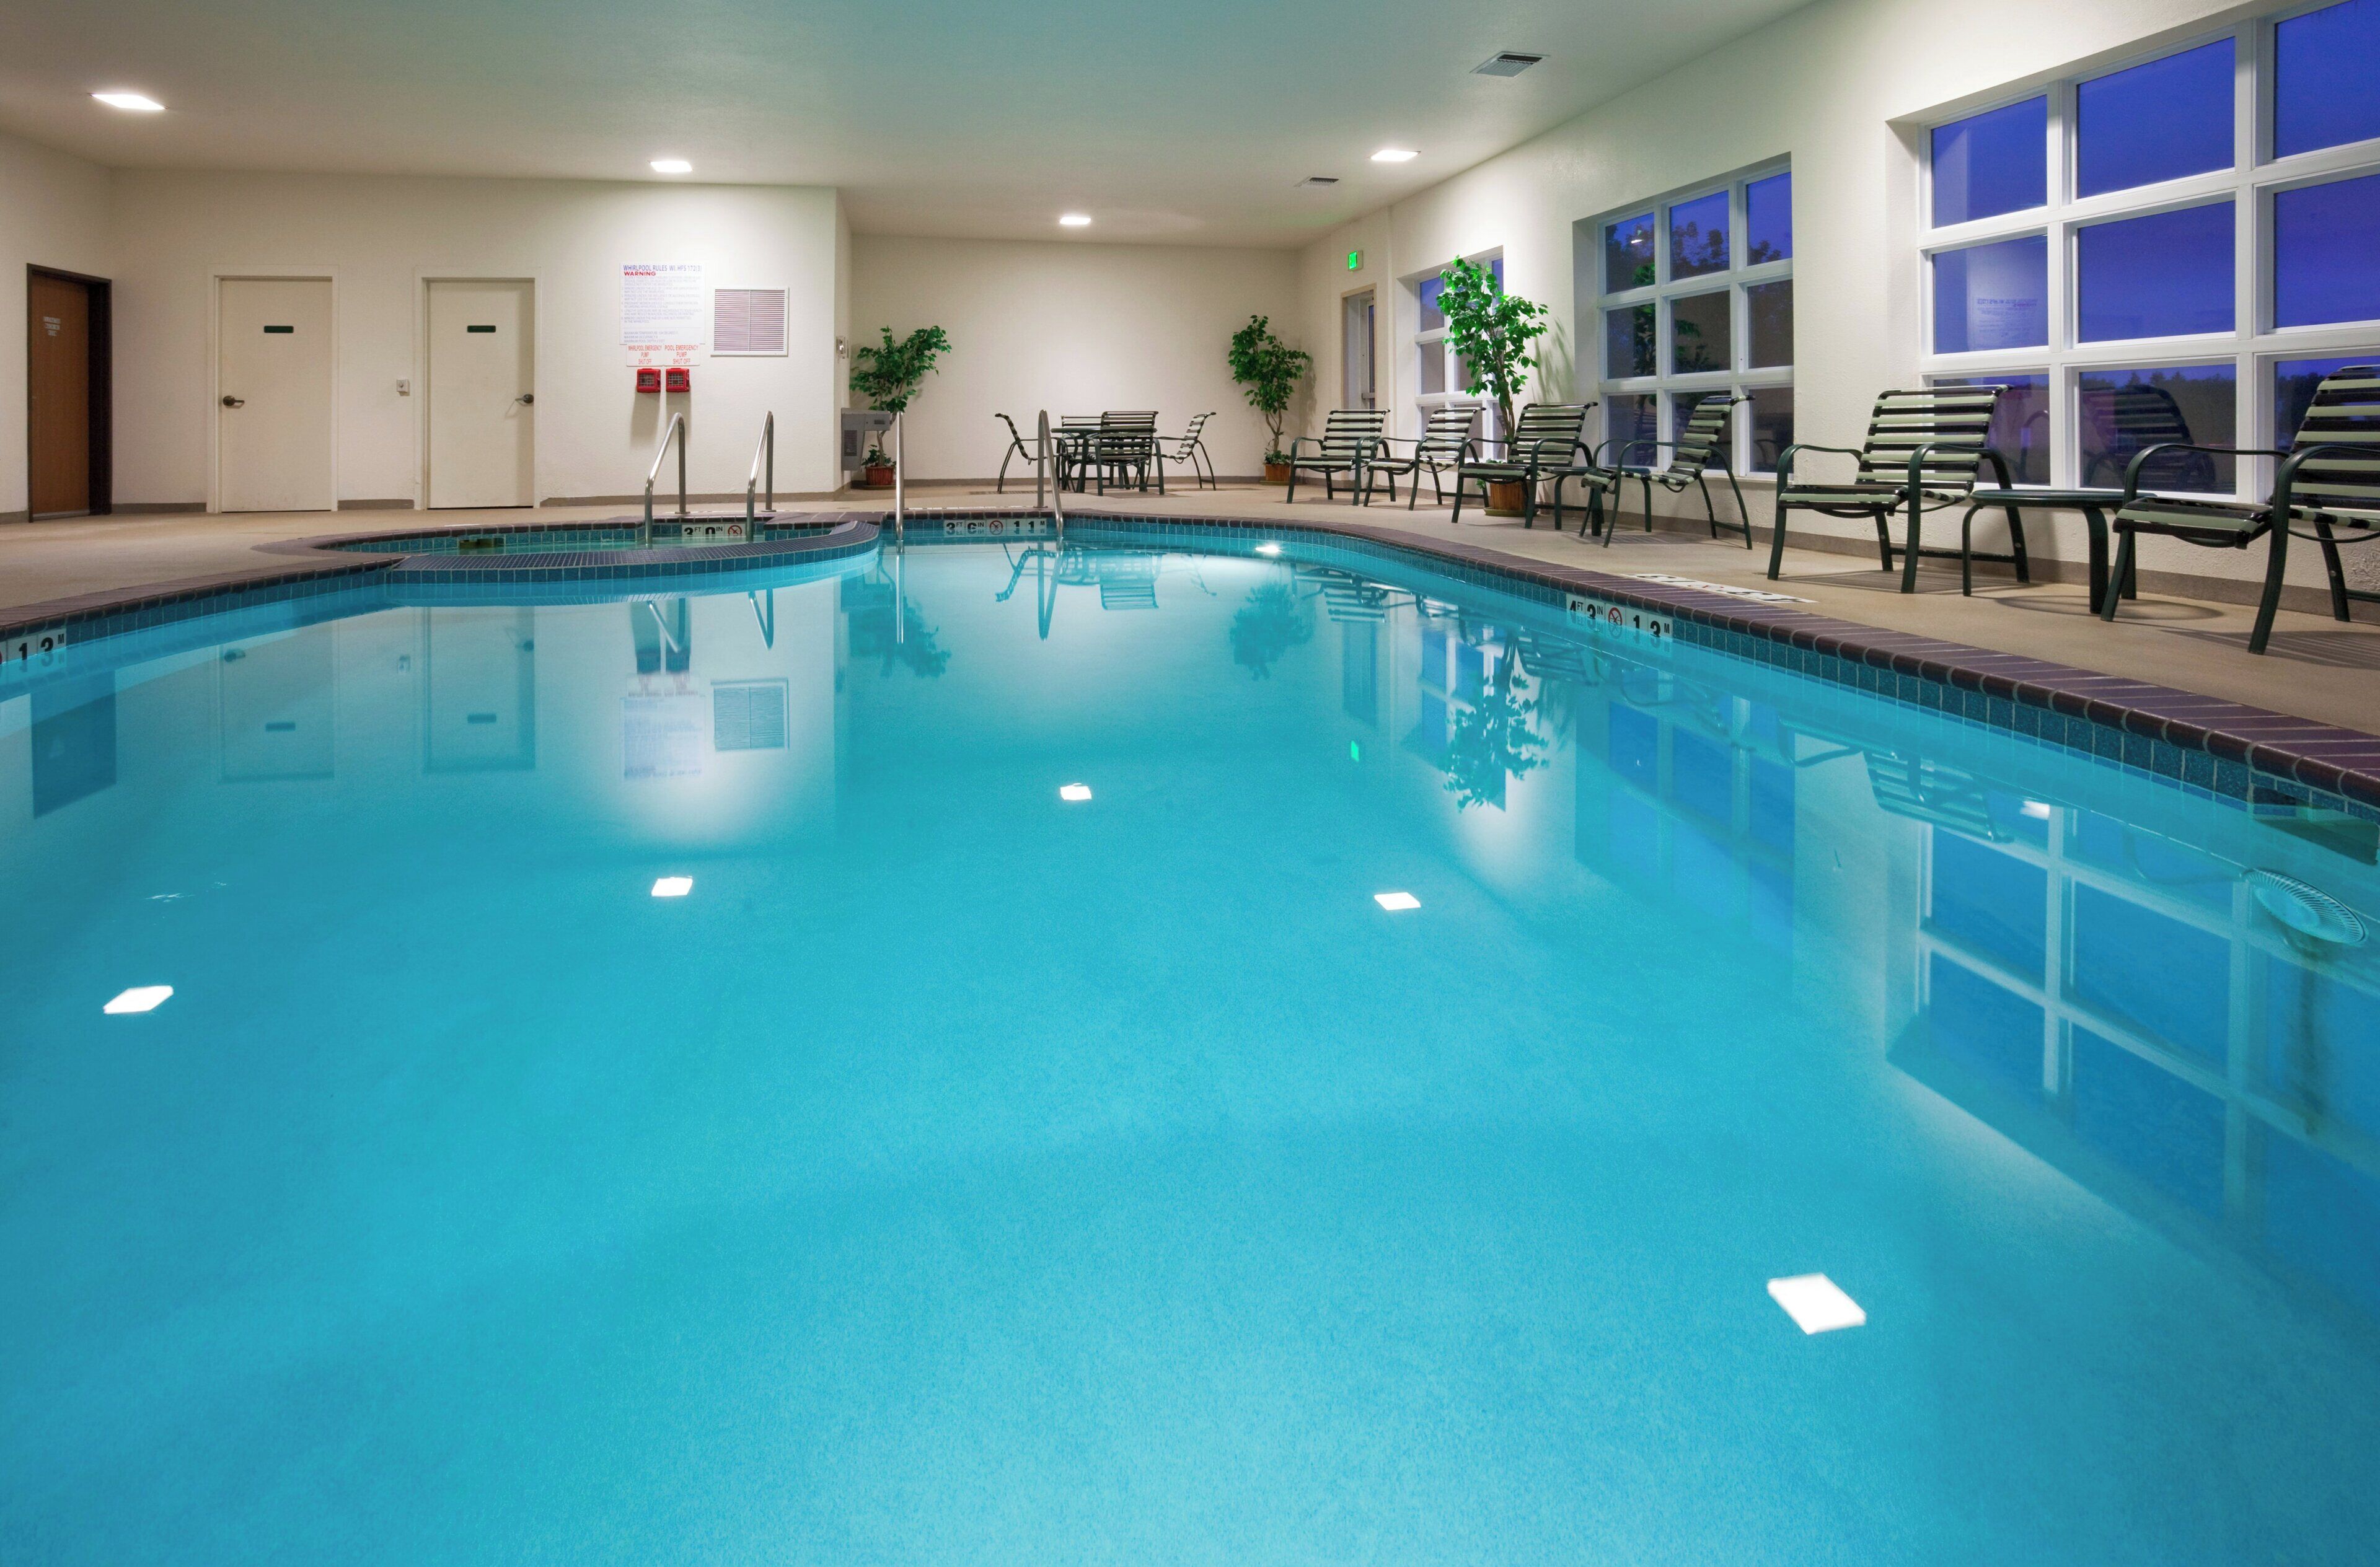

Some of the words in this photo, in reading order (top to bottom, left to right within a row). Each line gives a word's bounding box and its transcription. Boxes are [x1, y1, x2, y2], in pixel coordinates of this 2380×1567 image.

[1577, 601, 1584, 611] FT
[1597, 605, 1603, 615] IN
[1664, 623, 1670, 634] M
[58, 633, 64, 644] M
